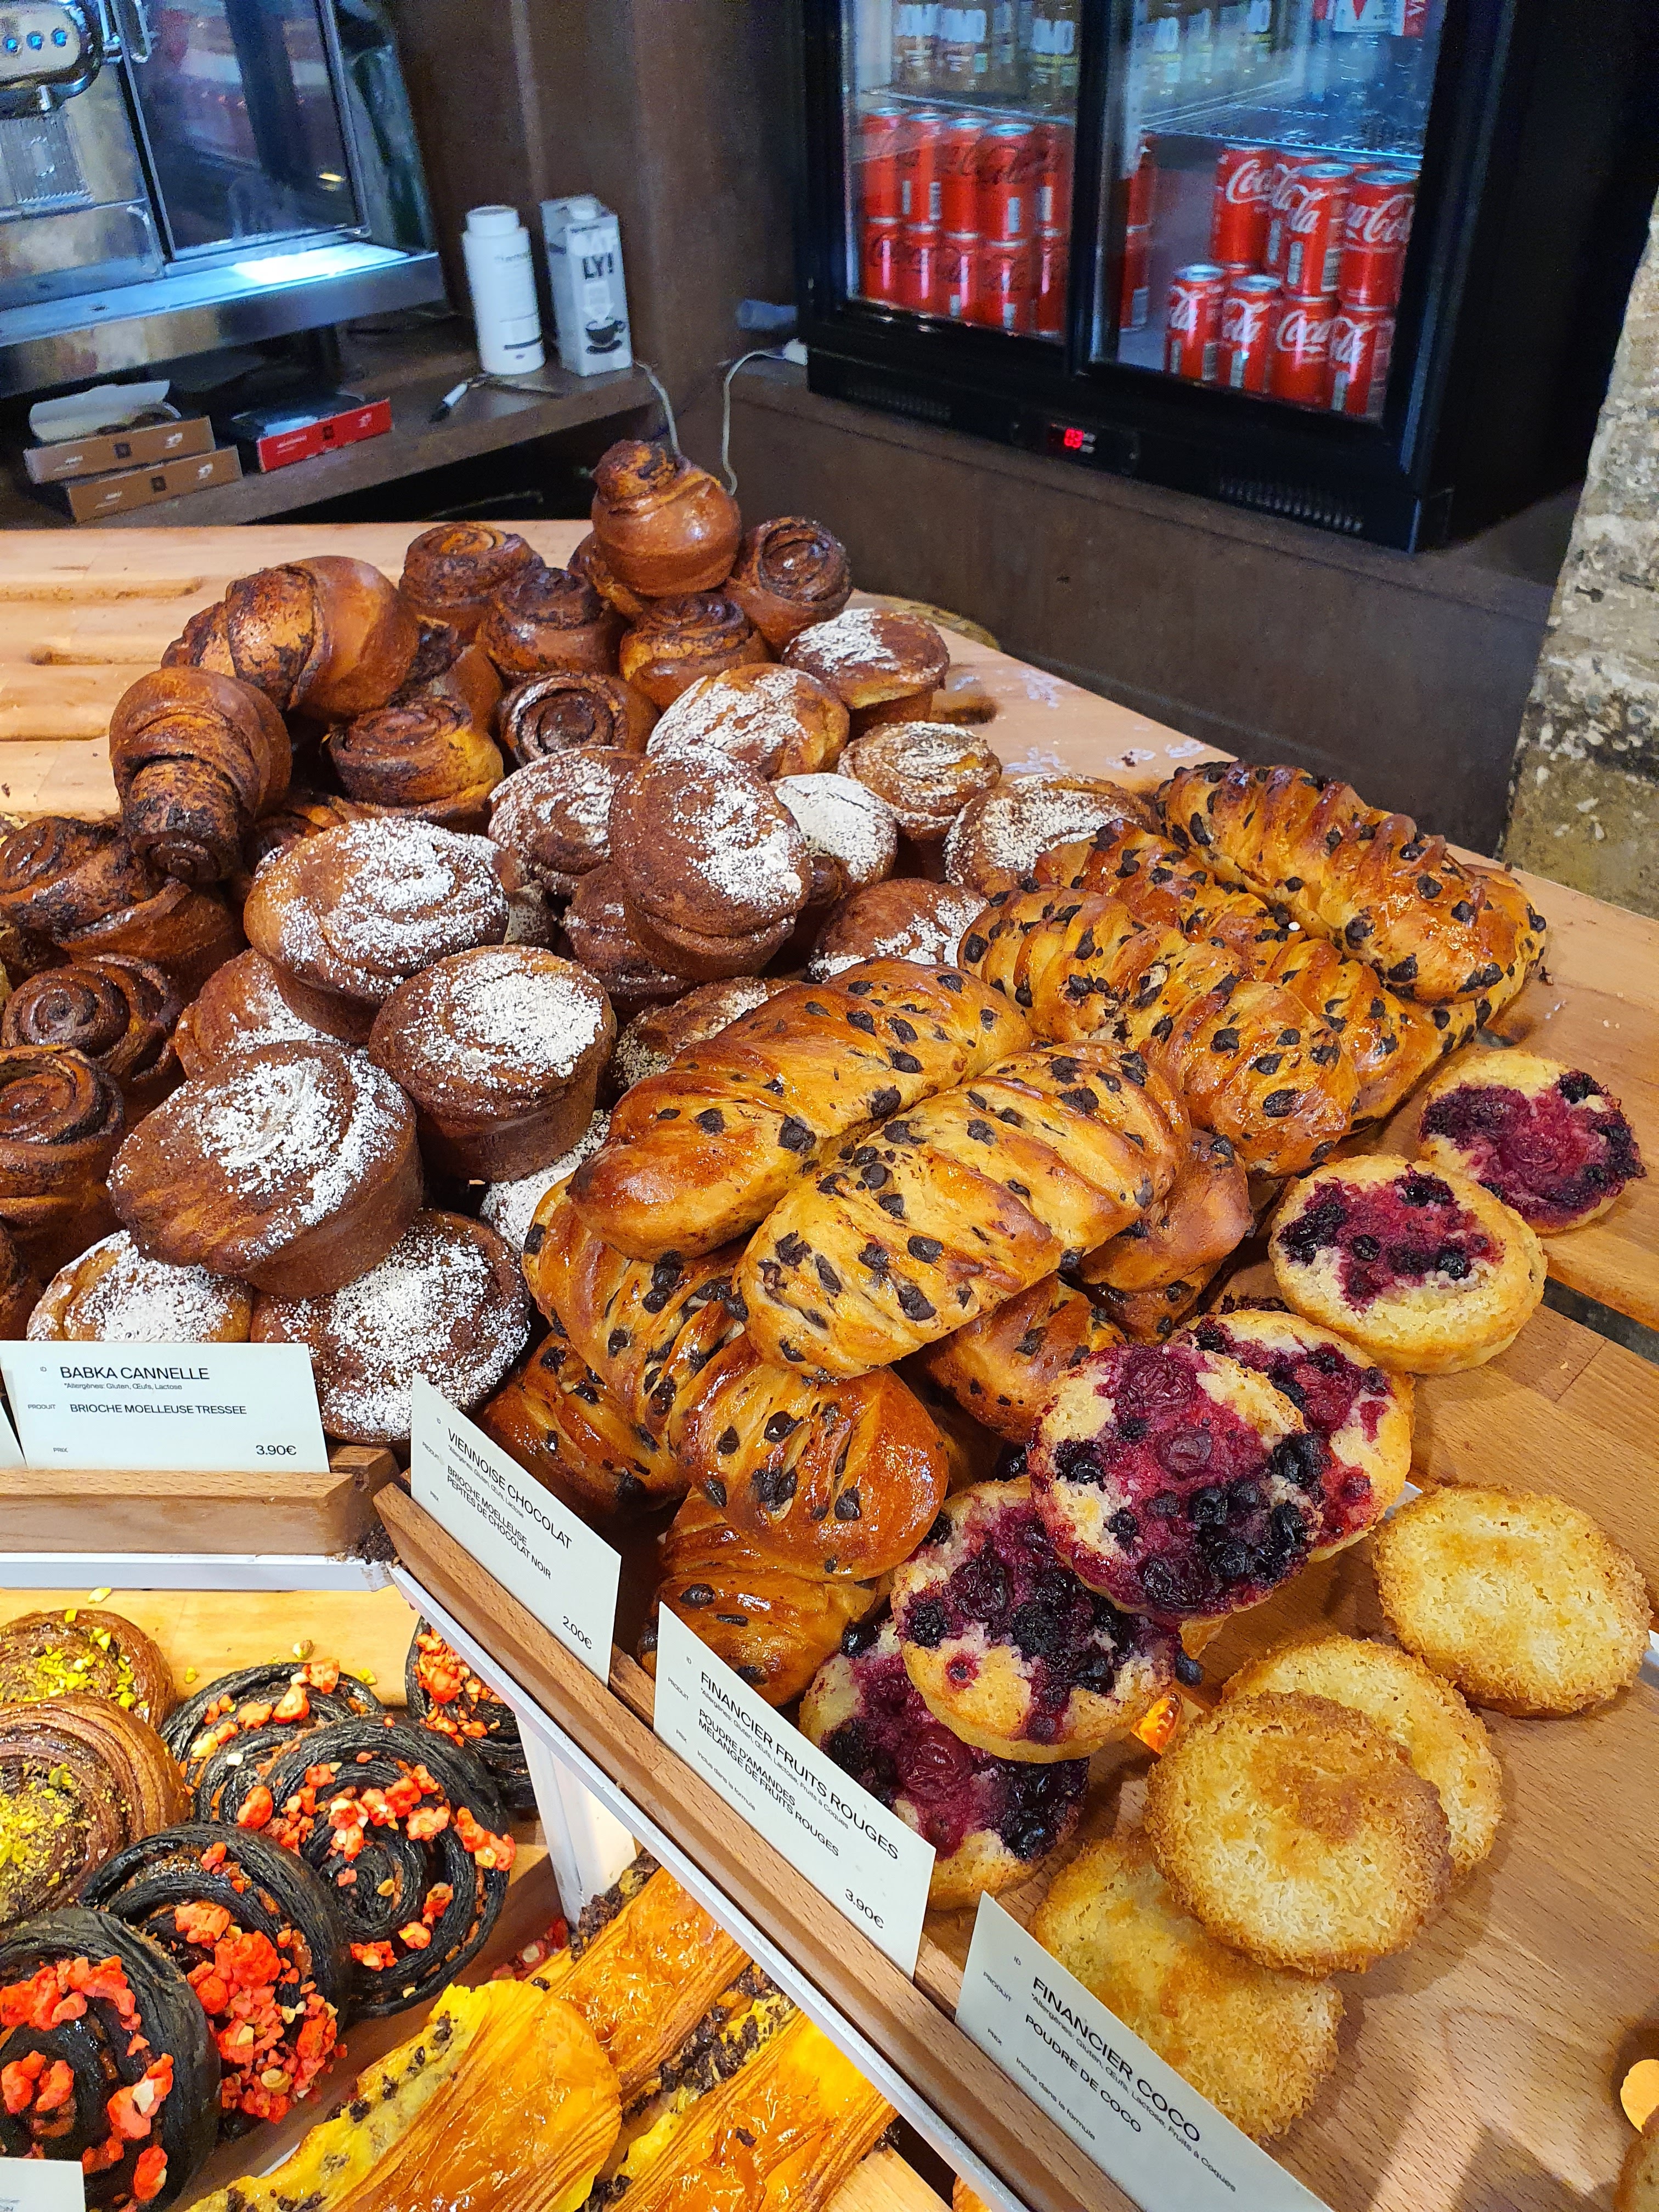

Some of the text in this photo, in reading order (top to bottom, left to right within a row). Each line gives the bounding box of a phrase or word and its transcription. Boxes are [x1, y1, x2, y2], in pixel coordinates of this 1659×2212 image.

[60, 1367, 210, 1380] BABKA CANNELLE
[70, 1404, 247, 1414] BRIOCHE MOELLEUSE TRESSEE
[256, 1445, 297, 1455] 3.90€
[448, 1427, 572, 1549] VIENNOISE CHOCOLAT
[448, 1465, 527, 1546] BRIOCHE MOELLEUSE
[448, 1475, 551, 1579] PEPITES DE CHOCOLAT NOIR
[668, 1677, 689, 1700] PRODUIT
[697, 1750, 713, 1769] Inclus
[714, 1768, 727, 1784] dans
[734, 1787, 755, 1811] formule
[698, 1718, 839, 1857] MELANGE DE FRUITS ROUGES
[699, 1708, 795, 1806] POUDRE D'AMANDES
[701, 1671, 899, 1859] FINANCIER FRUITS ROUGES
[800, 1782, 817, 1801] Fruits
[823, 1804, 849, 1830] Coques
[845, 1888, 884, 1929] 3.90€
[983, 1971, 1012, 2002] PRODUIT
[1025, 2014, 1141, 2132] POUDRE DE COCO
[1033, 1976, 1200, 2142] FINANCIER COCO
